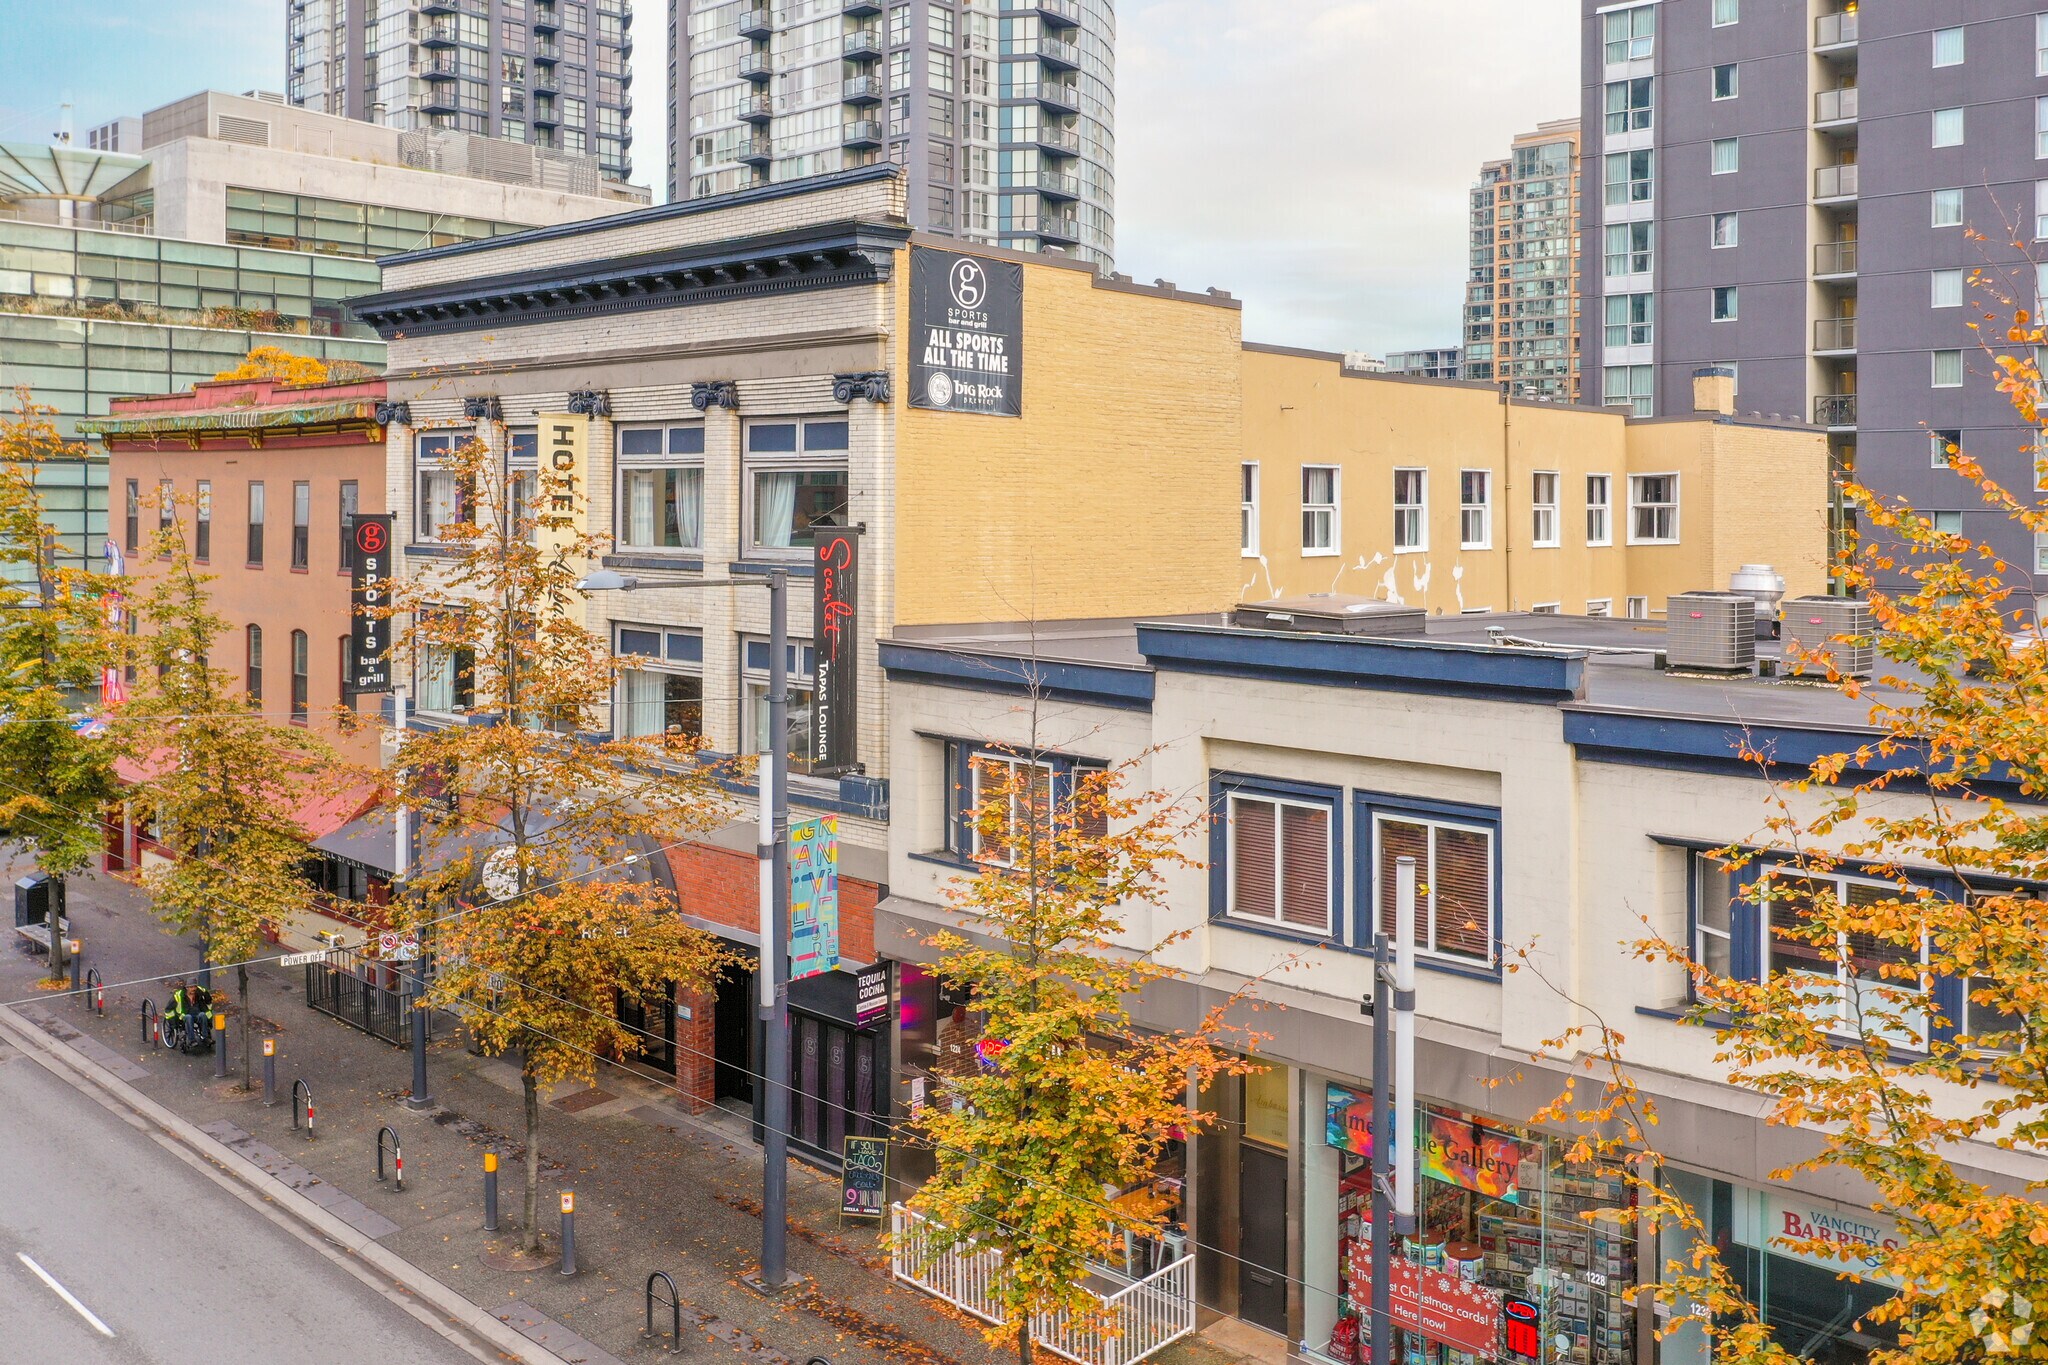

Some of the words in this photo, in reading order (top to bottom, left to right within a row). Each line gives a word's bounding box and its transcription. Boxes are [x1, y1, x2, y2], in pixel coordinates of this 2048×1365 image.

[947, 308, 988, 322] SPORTS
[948, 317, 961, 326] bar
[960, 319, 974, 328] and
[974, 321, 988, 329] grill
[929, 328, 952, 349] ALL
[956, 332, 1004, 355] SPORTS
[923, 346, 947, 366] ALL
[950, 349, 974, 370] THE
[977, 352, 1008, 374] TIME
[977, 383, 1004, 399] Rock
[552, 425, 574, 532] HOTEL
[820, 538, 853, 662] Scarlet
[359, 674, 384, 686] grill
[819, 660, 829, 701] TAPAS
[819, 706, 829, 761] LOUNGE
[284, 954, 308, 966] POWER
[311, 952, 323, 963] OFF
[858, 970, 886, 987] TEQUILA
[859, 983, 885, 999] COCINA
[1328, 1103, 1374, 1135] Time
[852, 1153, 875, 1168] TACO
[1442, 1138, 1518, 1183] Gallery
[1810, 1211, 1881, 1240] VANCITY
[1585, 1271, 1607, 1287] 1228
[1355, 1268, 1373, 1285] The
[1400, 1284, 1454, 1314] Christmas
[1456, 1306, 1490, 1326] cards!
[1690, 1302, 1711, 1319] 123
[1394, 1303, 1419, 1321] Here
[1422, 1316, 1447, 1332] now!
